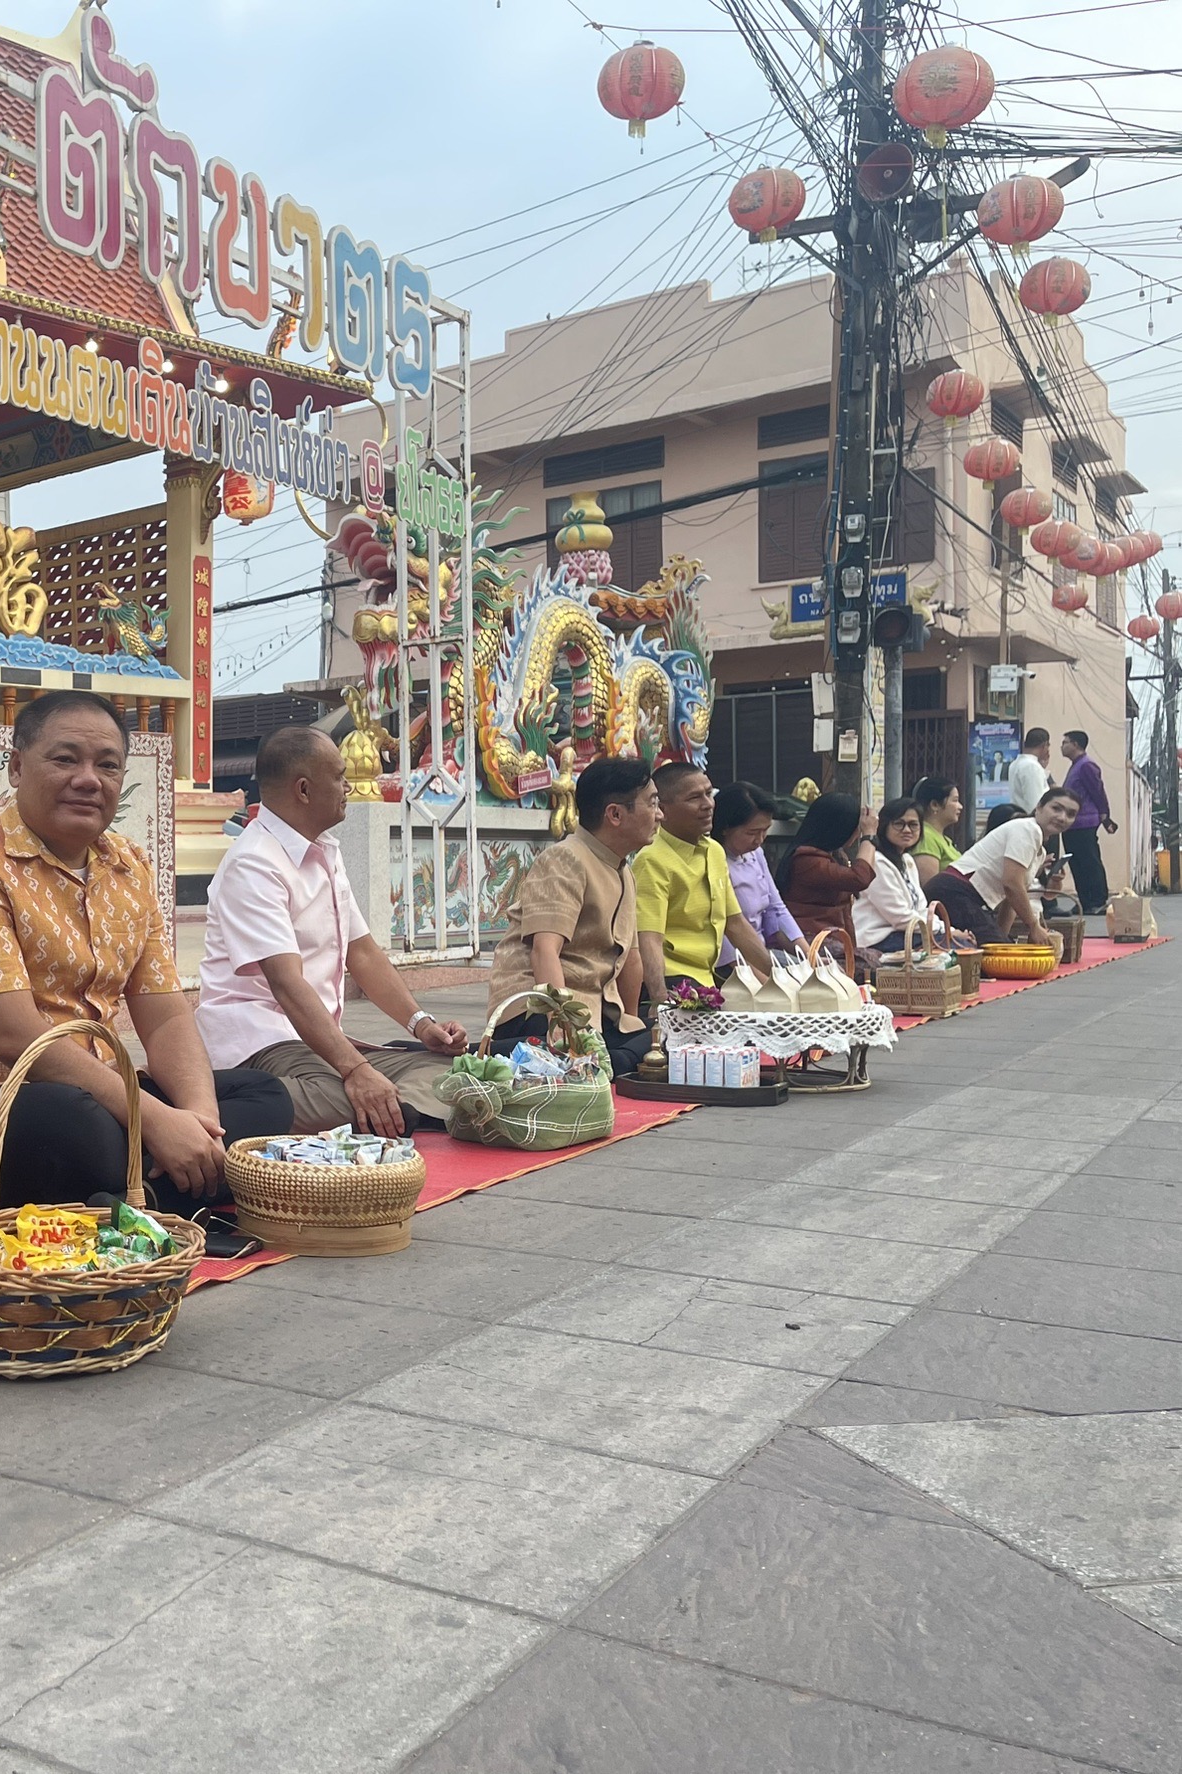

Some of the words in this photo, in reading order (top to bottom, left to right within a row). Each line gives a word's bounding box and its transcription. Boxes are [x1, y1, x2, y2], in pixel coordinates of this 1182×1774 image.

[36, 6, 434, 401] ตักบาตร
[360, 438, 385, 513] @
[396, 426, 466, 538] ยโสธร
